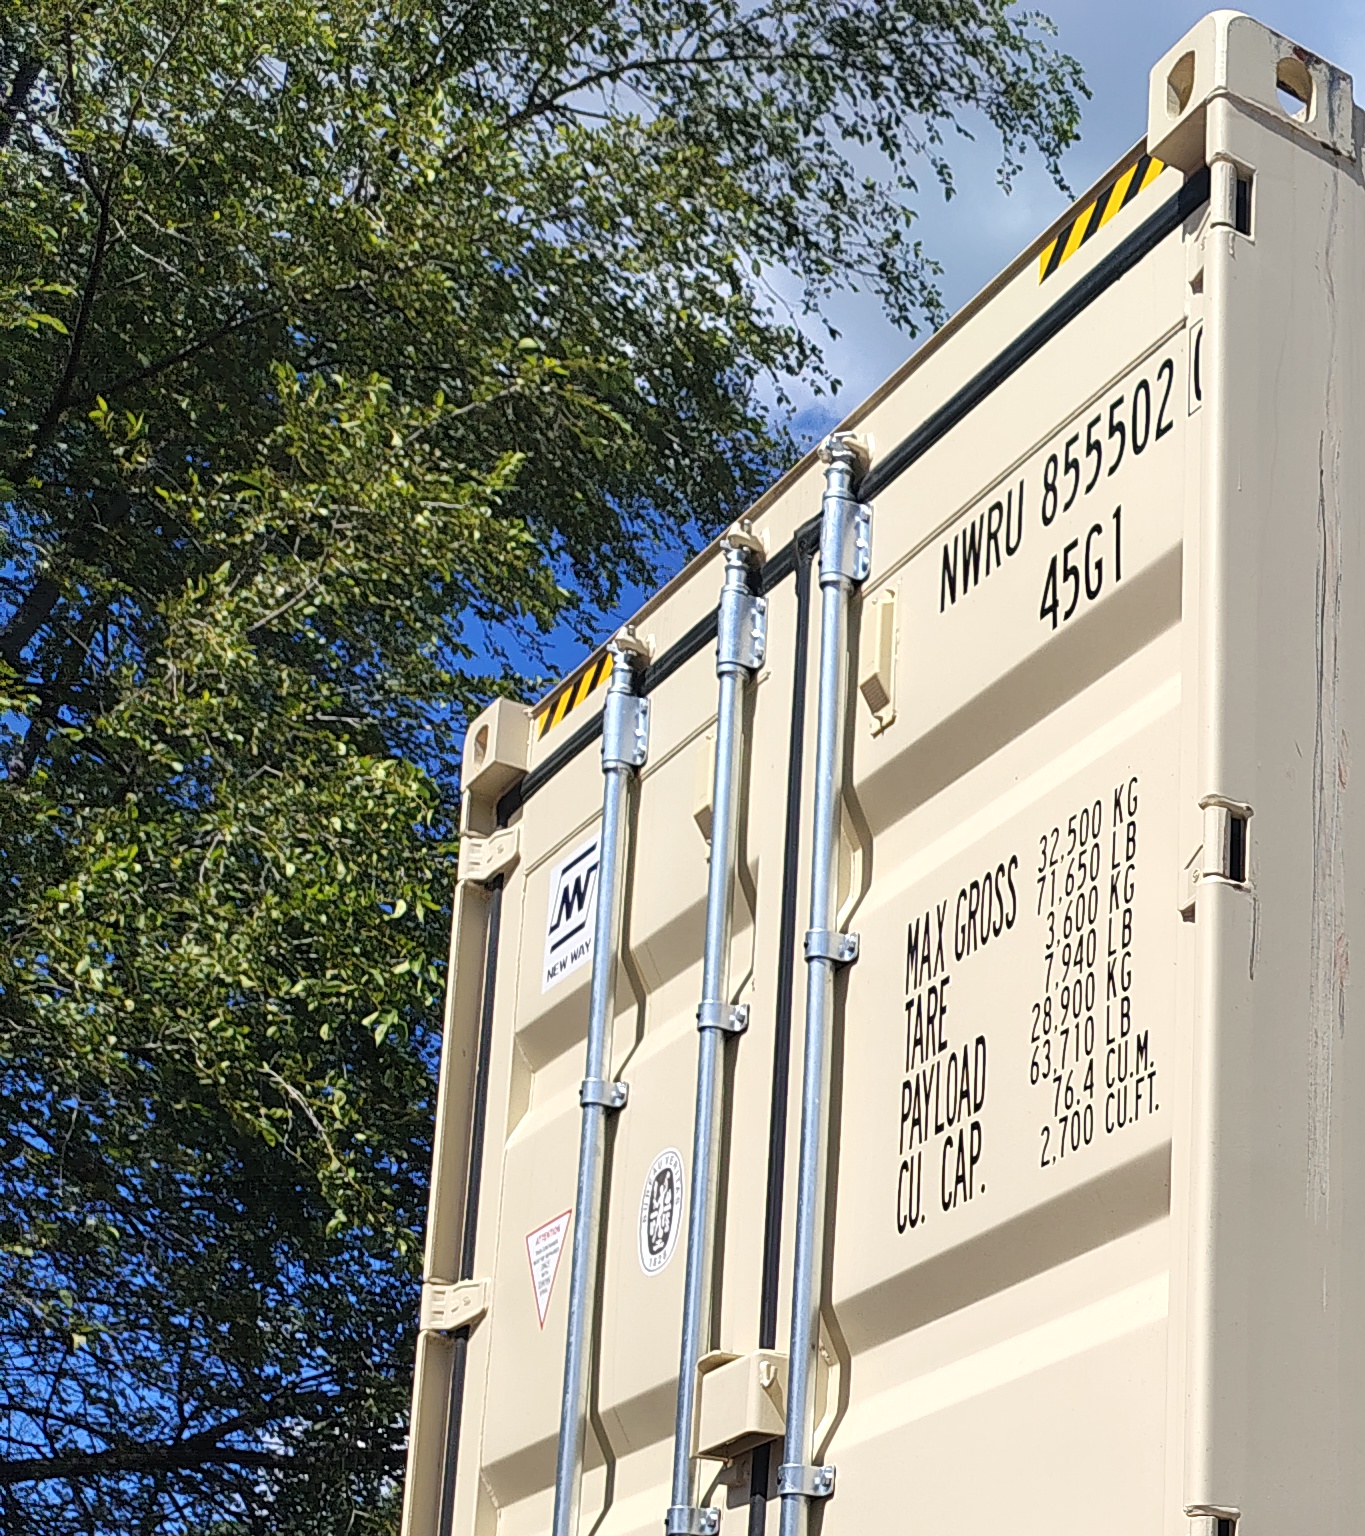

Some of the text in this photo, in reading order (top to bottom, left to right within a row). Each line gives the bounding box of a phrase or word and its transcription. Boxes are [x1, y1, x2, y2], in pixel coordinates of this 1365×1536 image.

[941, 480, 1024, 613] NWRU
[1042, 358, 1174, 527] 855502
[1040, 505, 1122, 630] 45G1
[906, 777, 1138, 996] MAX GROSS 32,500 KG
[1037, 821, 1137, 916] 71,650 LB
[547, 938, 591, 982] NEW WAY
[905, 864, 1135, 1073] TARE 3,600 KG
[1045, 908, 1132, 994] 7,940 LB
[900, 951, 1131, 1156] PAYLOAD 28,900 KG
[1030, 996, 1131, 1086] 63,710 LB
[897, 1030, 1154, 1235] CU. CAP. 76.4 CU.M.
[1041, 1071, 1160, 1168] 2,700 CU.FT.
